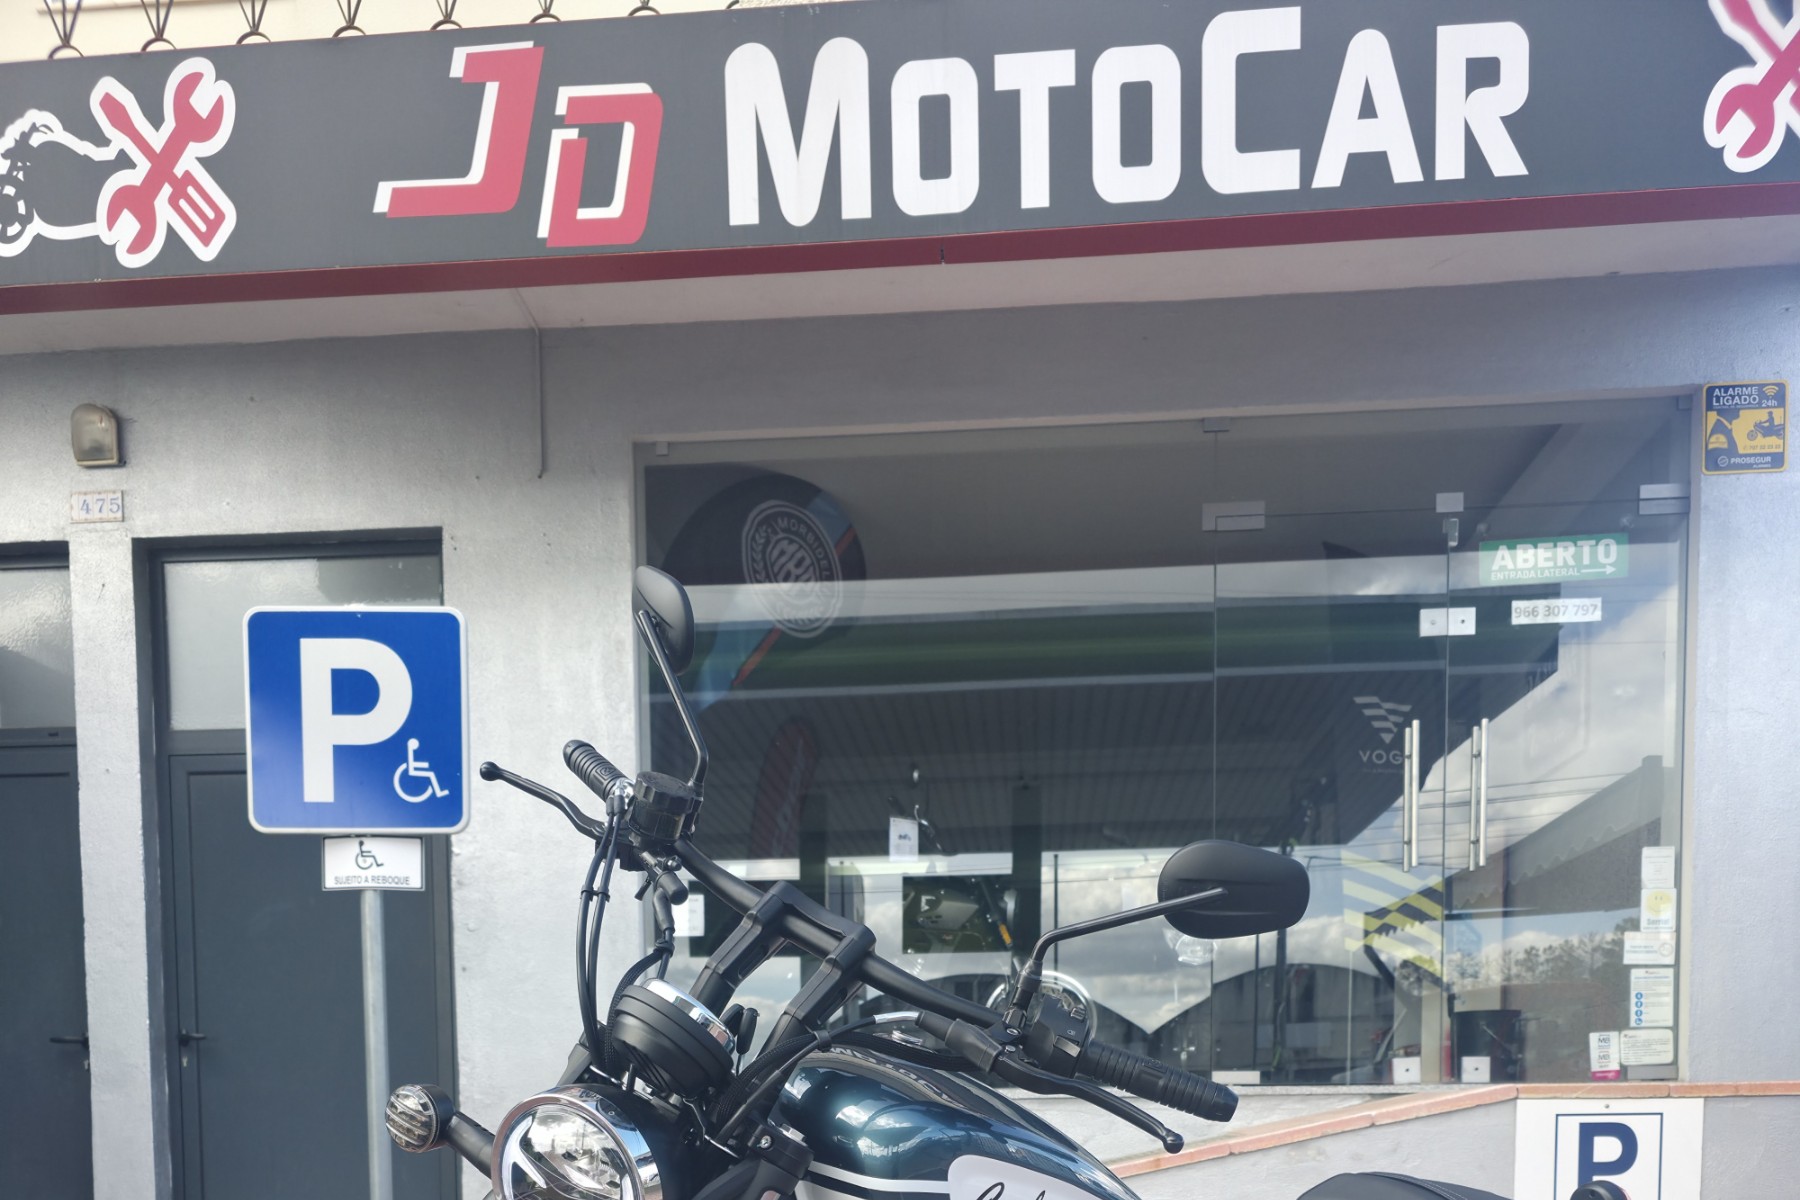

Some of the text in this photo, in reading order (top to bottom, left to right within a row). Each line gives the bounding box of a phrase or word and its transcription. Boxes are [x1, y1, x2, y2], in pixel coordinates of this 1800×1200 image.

[1713, 386, 1759, 397] ALARME
[1712, 395, 1759, 406] LIGADO
[1761, 399, 1778, 407] 24h
[1730, 456, 1772, 464] PROSEGUR
[80, 496, 121, 515] 475
[1491, 538, 1618, 570] ABERTO
[1491, 567, 1581, 581] ENTRADA LATERAL
[1514, 603, 1598, 618] 966 307 797
[300, 638, 413, 803] P
[1358, 750, 1404, 765] VOG
[334, 875, 411, 886] SUJEITO A REBOQUE
[1577, 1122, 1639, 1189] P
